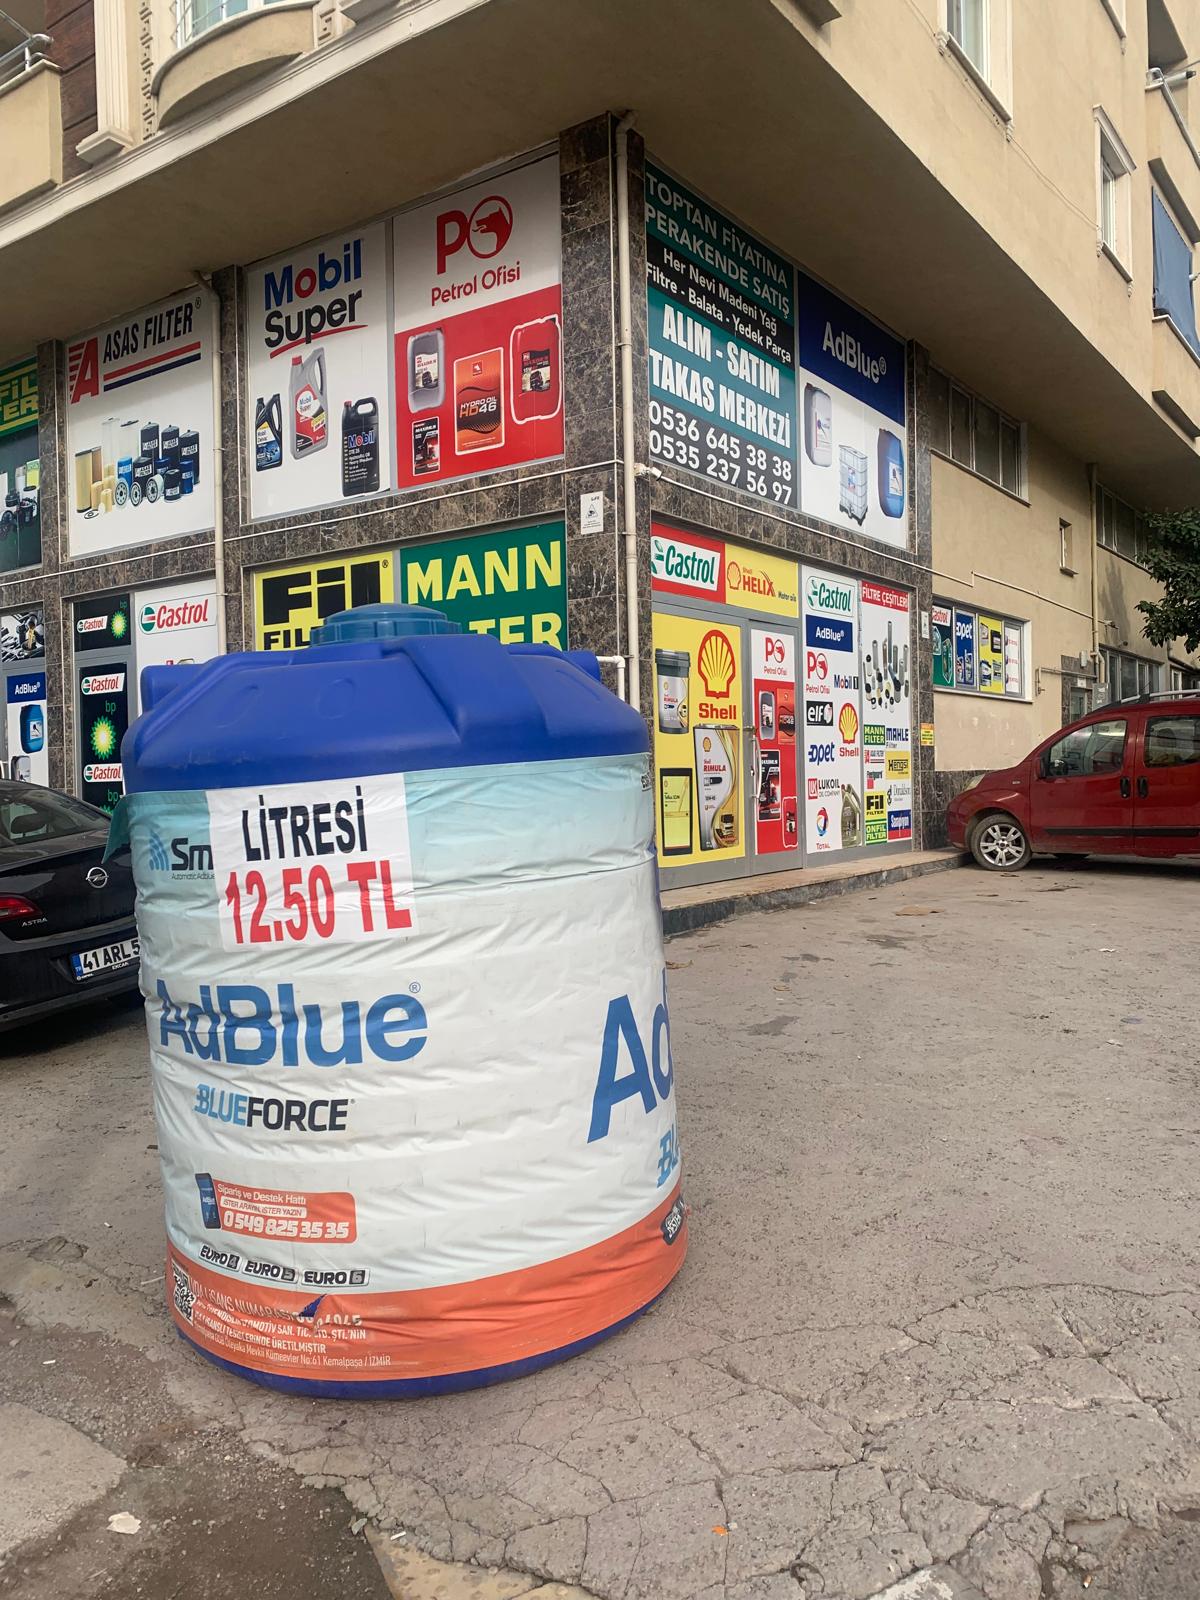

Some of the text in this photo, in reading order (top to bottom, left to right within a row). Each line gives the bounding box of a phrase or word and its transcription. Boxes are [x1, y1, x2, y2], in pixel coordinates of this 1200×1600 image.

[645, 172, 788, 289] TOPTAN FİYATINA
[645, 201, 790, 320] PERAKENDE SATIŞ
[264, 238, 363, 310] Mobil
[431, 260, 520, 307] Petrol Ofisi
[663, 247, 778, 337] Her Nevi Madeni Yağ
[264, 288, 363, 348] Super
[645, 264, 678, 295] Filtre
[688, 290, 723, 323] Balata
[732, 315, 763, 347] Yedek
[765, 336, 792, 366] Parça
[102, 323, 140, 364] ASAS
[662, 304, 712, 363] ALIM
[726, 340, 780, 400] SATIM
[460, 396, 497, 409] HYDRO OIL
[648, 347, 791, 450] TAKAS MERKEZİ
[349, 430, 375, 448] Mobil
[648, 400, 792, 482] 0536 645 38 38
[648, 429, 792, 505] 0535 237 56 97
[406, 540, 562, 605] MANN
[665, 545, 715, 585] Castrol
[742, 574, 776, 597] HELIX
[818, 582, 851, 612] Castrol
[862, 583, 881, 601] FİLTRE
[83, 617, 104, 631] Castrol
[156, 598, 209, 629] Castrol
[91, 676, 119, 692] Castrol
[833, 674, 852, 690] Mobil
[105, 700, 116, 715] bp
[698, 702, 737, 720] Shell
[807, 705, 824, 723] elf
[864, 724, 885, 735] MANN
[864, 734, 886, 744] FILTER
[886, 727, 909, 742] MAHLE
[839, 747, 859, 758] Shell
[93, 765, 121, 781] Castrol
[703, 764, 726, 773] RIMULA
[818, 778, 840, 790] LUKOIL
[107, 790, 119, 803] bp
[242, 785, 368, 862] LİTRESİ
[225, 859, 413, 944] 12.50 TL
[21, 916, 48, 928] ASTRA
[83, 951, 99, 970] 41
[103, 944, 130, 966] ARL
[216, 1183, 242, 1200] Sipariş
[242, 1190, 253, 1200] ve
[253, 1191, 284, 1204] Destek
[223, 1210, 350, 1239] 0 549 825 35 35
[200, 1245, 240, 1270] EURO 4
[244, 1260, 297, 1283] EURO 5
[304, 1270, 367, 1286] EURO 6
[322, 1354, 363, 1370] Kemalpaşa
[368, 1352, 392, 1367] İZMİR
